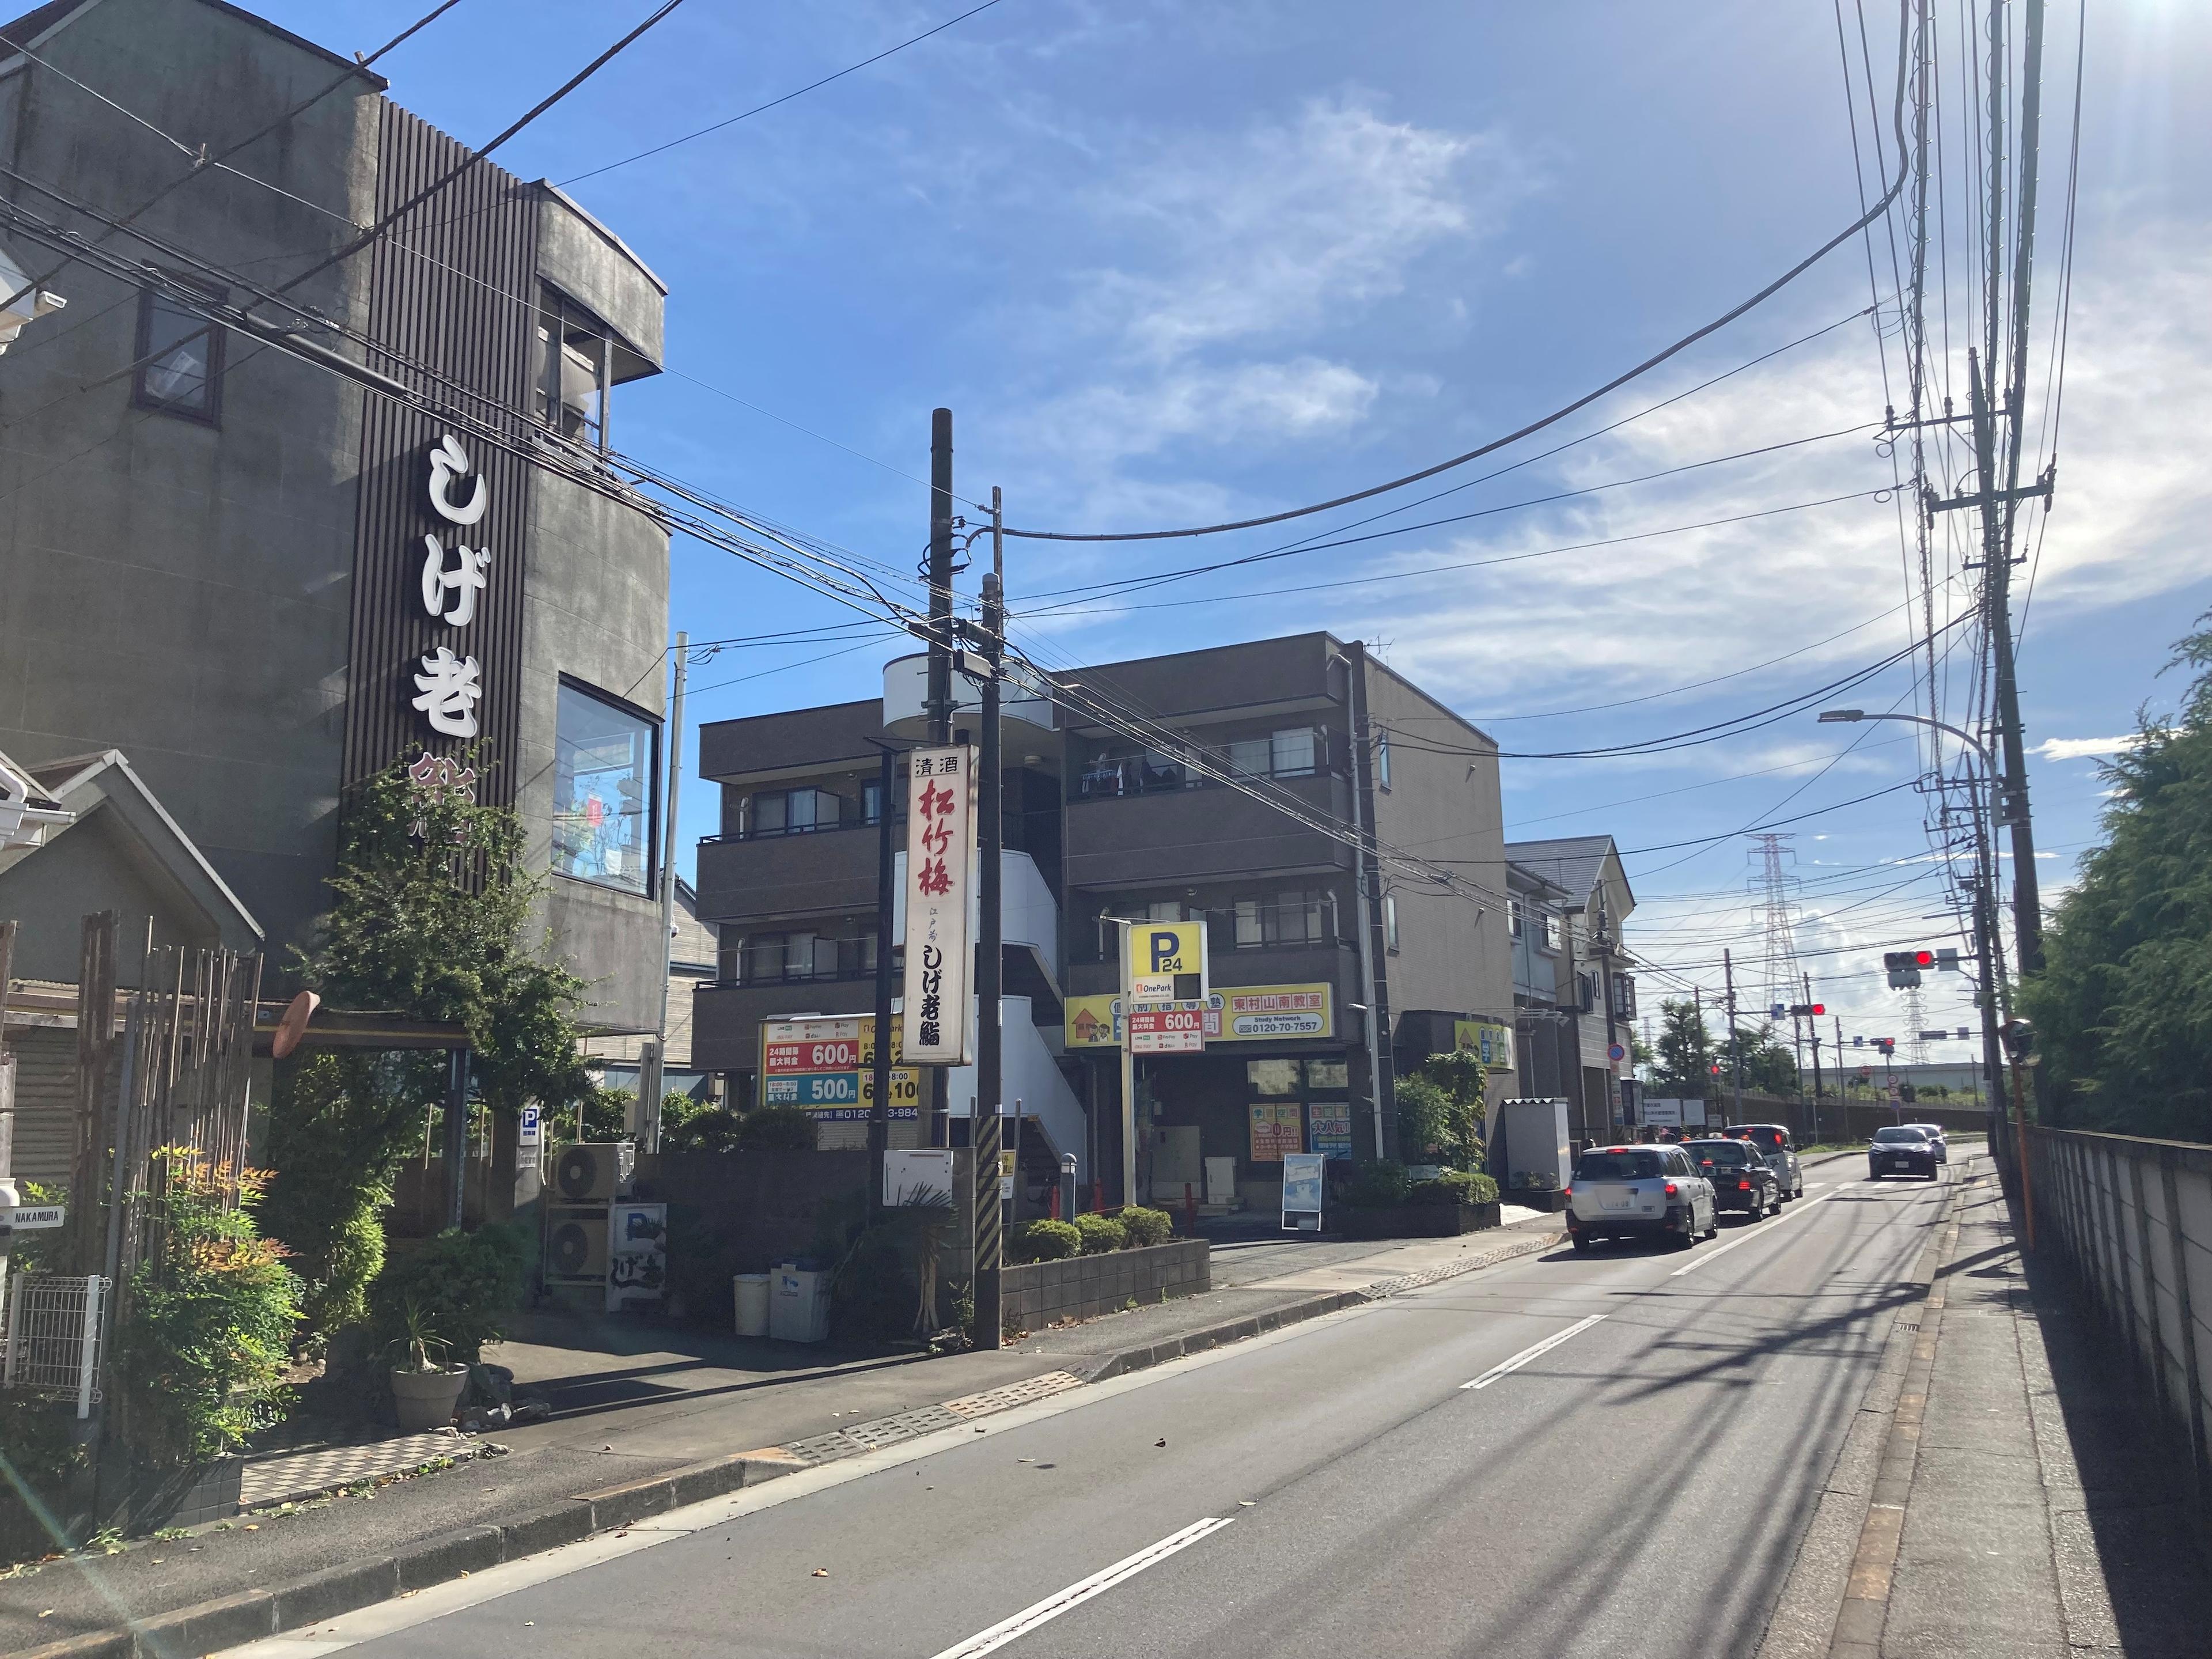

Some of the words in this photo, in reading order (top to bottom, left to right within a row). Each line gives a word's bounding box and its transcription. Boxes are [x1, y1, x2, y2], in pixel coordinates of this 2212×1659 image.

[915, 755, 958, 775] 清酒
[918, 779, 955, 896] 松竹梅
[1150, 931, 1180, 973] P
[1162, 958, 1183, 972] 24
[919, 945, 942, 1047] しげ老鮨
[1143, 984, 1171, 993] OnePark
[1233, 994, 1321, 1010] 東村山南教室
[1165, 1013, 1200, 1030] 600円
[1253, 1022, 1317, 1033] 0120-70-7557
[812, 1044, 857, 1065] 600円
[811, 1078, 856, 1100] 500円
[525, 1110, 536, 1126] P
[16, 1211, 59, 1224] NAKAMURA
